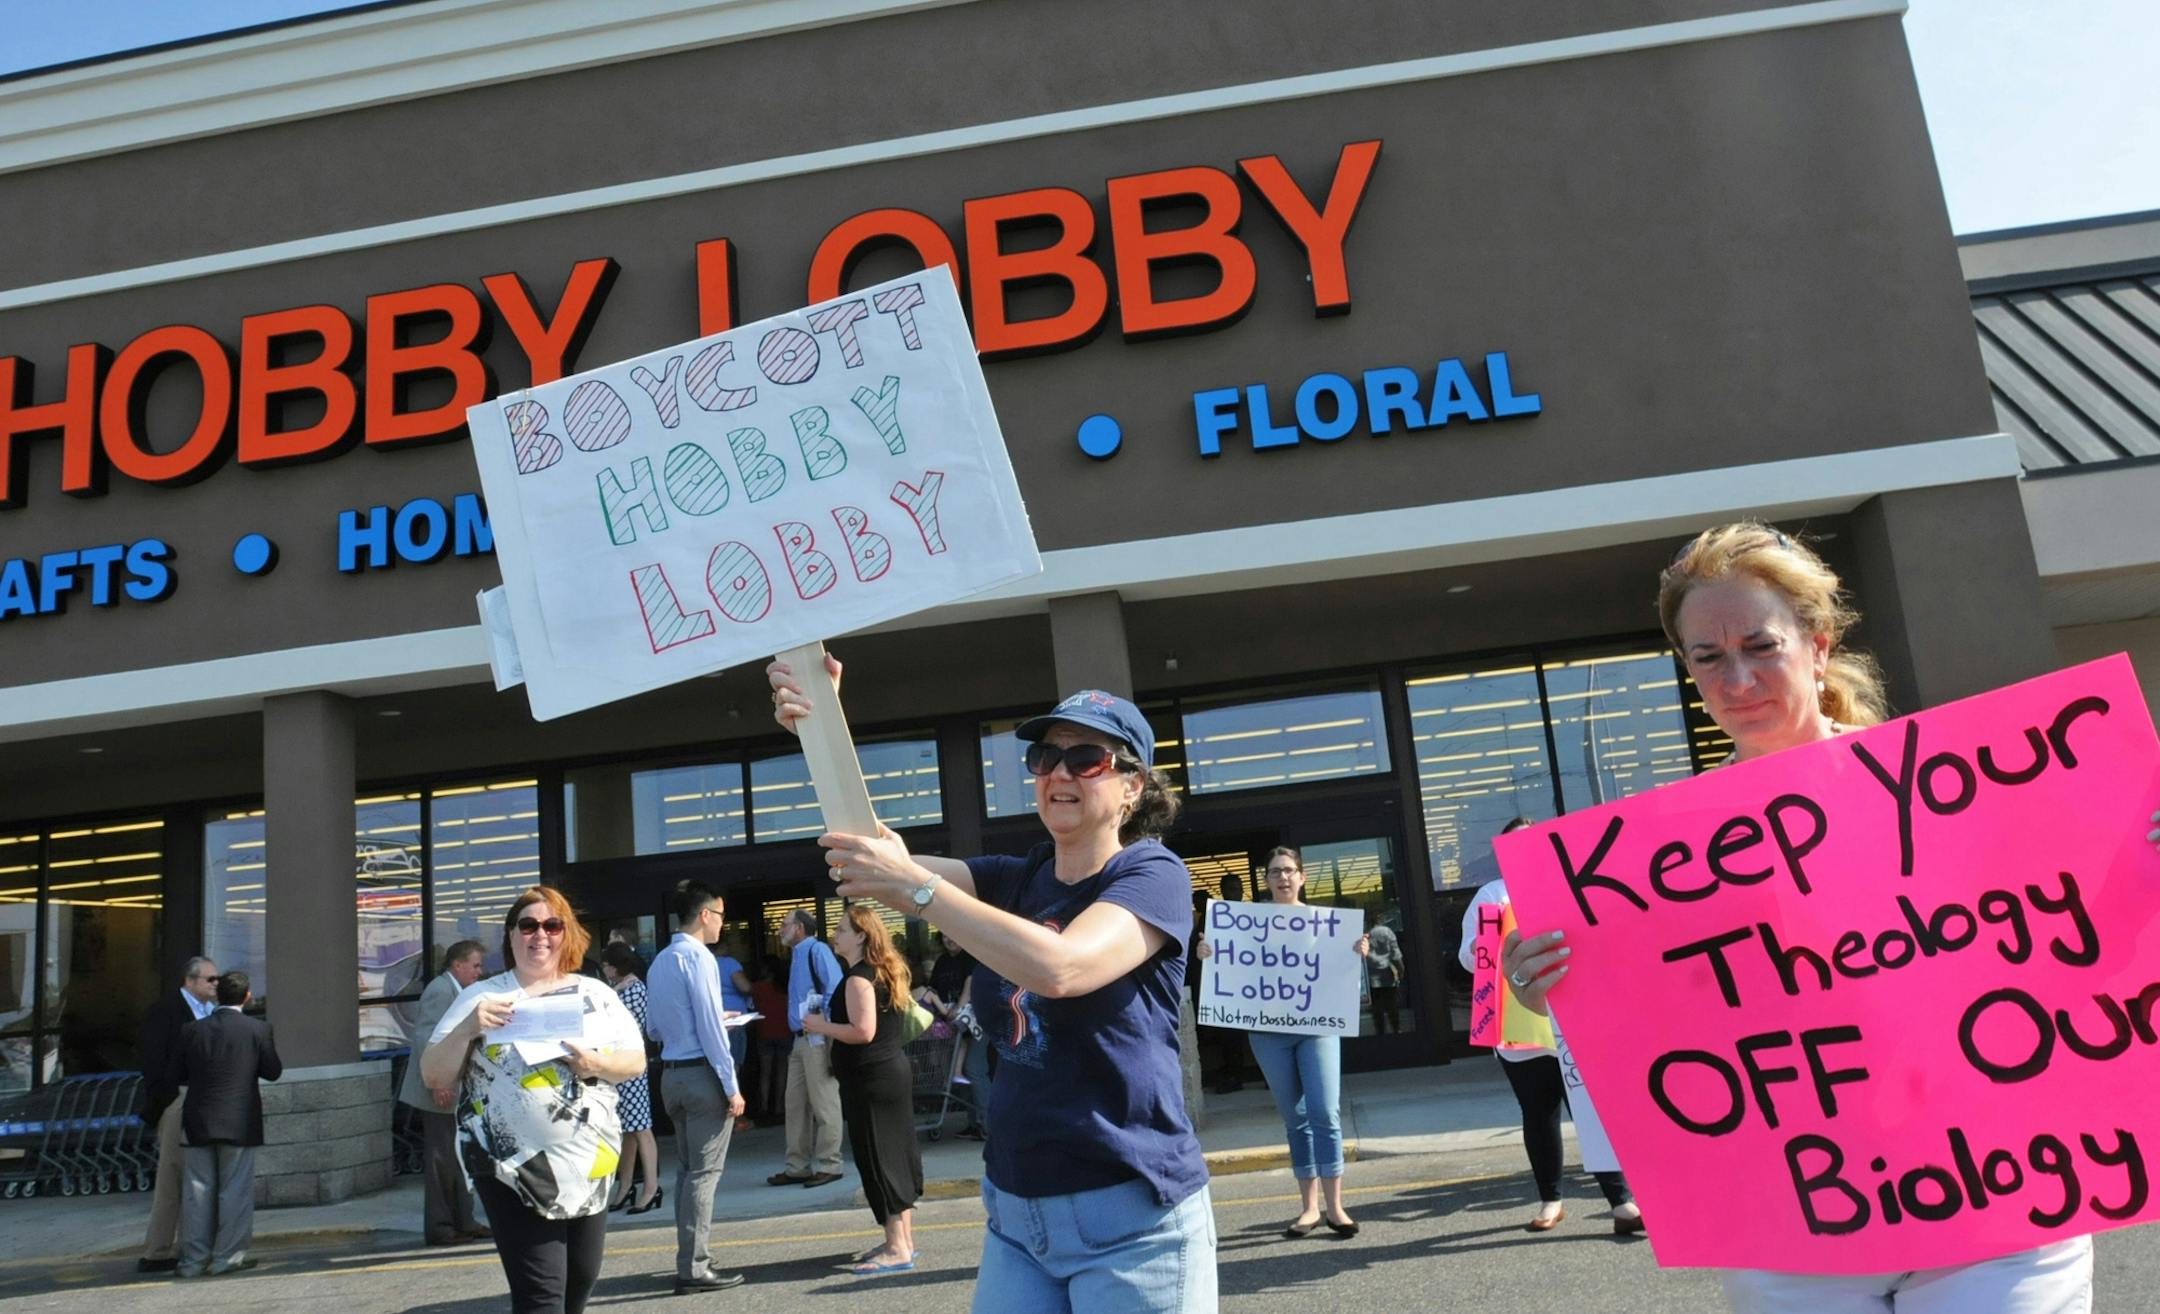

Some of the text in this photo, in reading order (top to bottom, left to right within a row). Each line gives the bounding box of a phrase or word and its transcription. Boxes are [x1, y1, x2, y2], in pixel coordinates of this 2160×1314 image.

[0, 257, 614, 502] HOBBY
[504, 284, 925, 475] BOYCOTT
[1193, 351, 1541, 456] FLORAL
[596, 375, 907, 546] HOBBY
[630, 470, 947, 654] LOBBY
[1550, 695, 2111, 927] Keep Your
[1211, 901, 1341, 943] Boycott
[1214, 938, 1320, 982] Hobby
[1214, 971, 1312, 1012] Lobby
[1662, 871, 2101, 1009] Theology
[1647, 982, 2160, 1138] OFF Our
[1783, 1127, 2149, 1235] Biology
